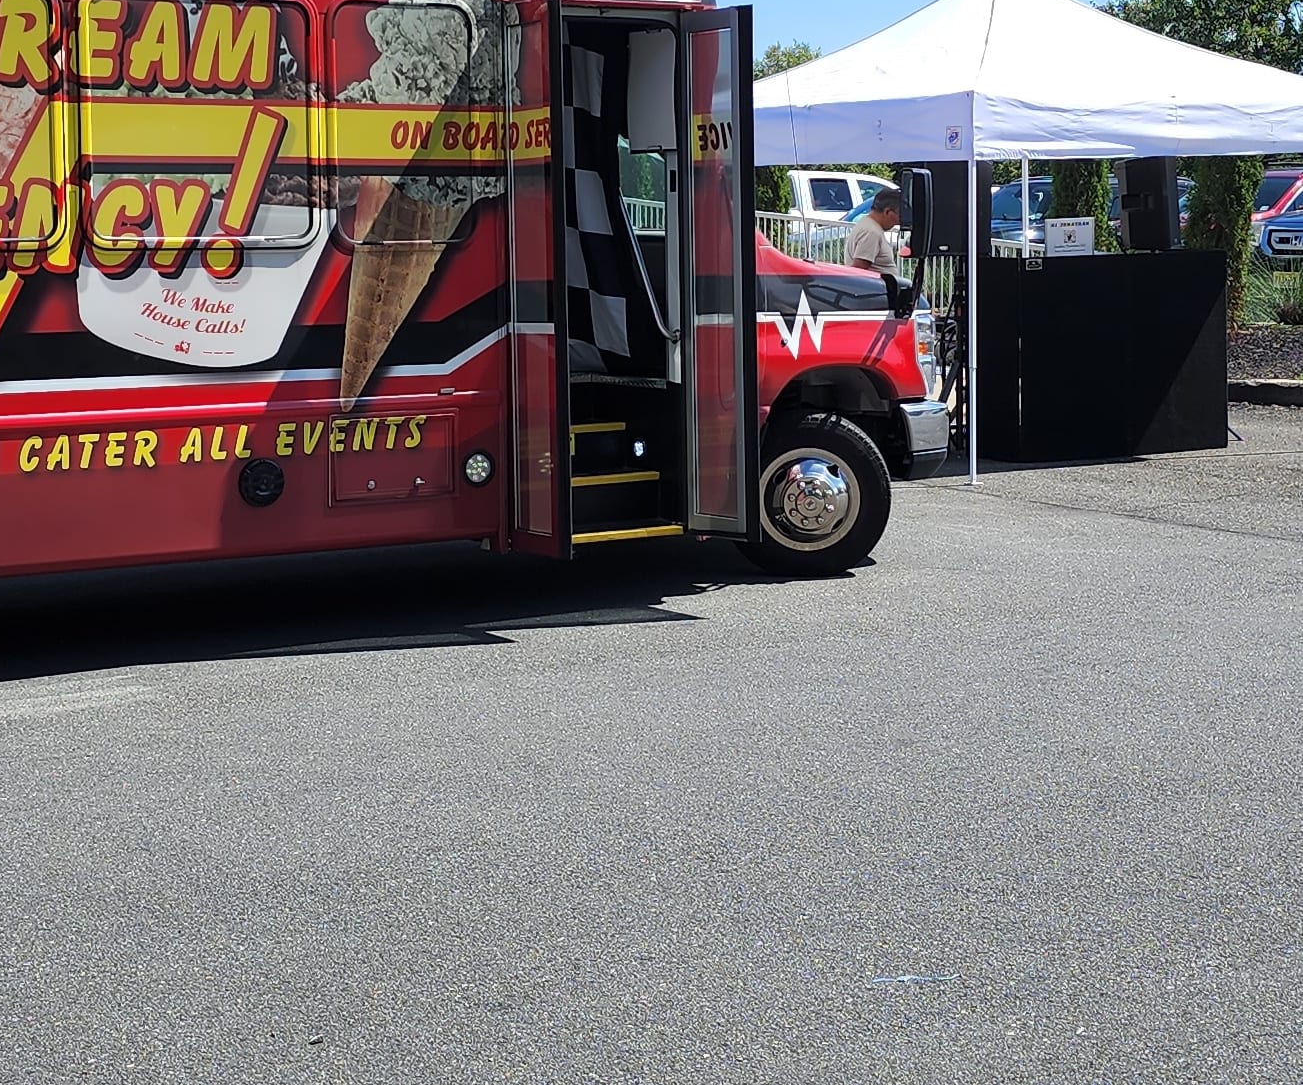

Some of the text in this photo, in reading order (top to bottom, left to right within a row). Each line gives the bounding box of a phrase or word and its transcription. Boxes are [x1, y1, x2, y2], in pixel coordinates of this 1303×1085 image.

[391, 120, 432, 151] ON
[442, 121, 520, 151] BOAD
[161, 288, 235, 314] We Make
[140, 302, 247, 334] House Calls!
[18, 429, 158, 474] CATER
[179, 423, 253, 464] ALL
[276, 414, 428, 458] EVENTS
